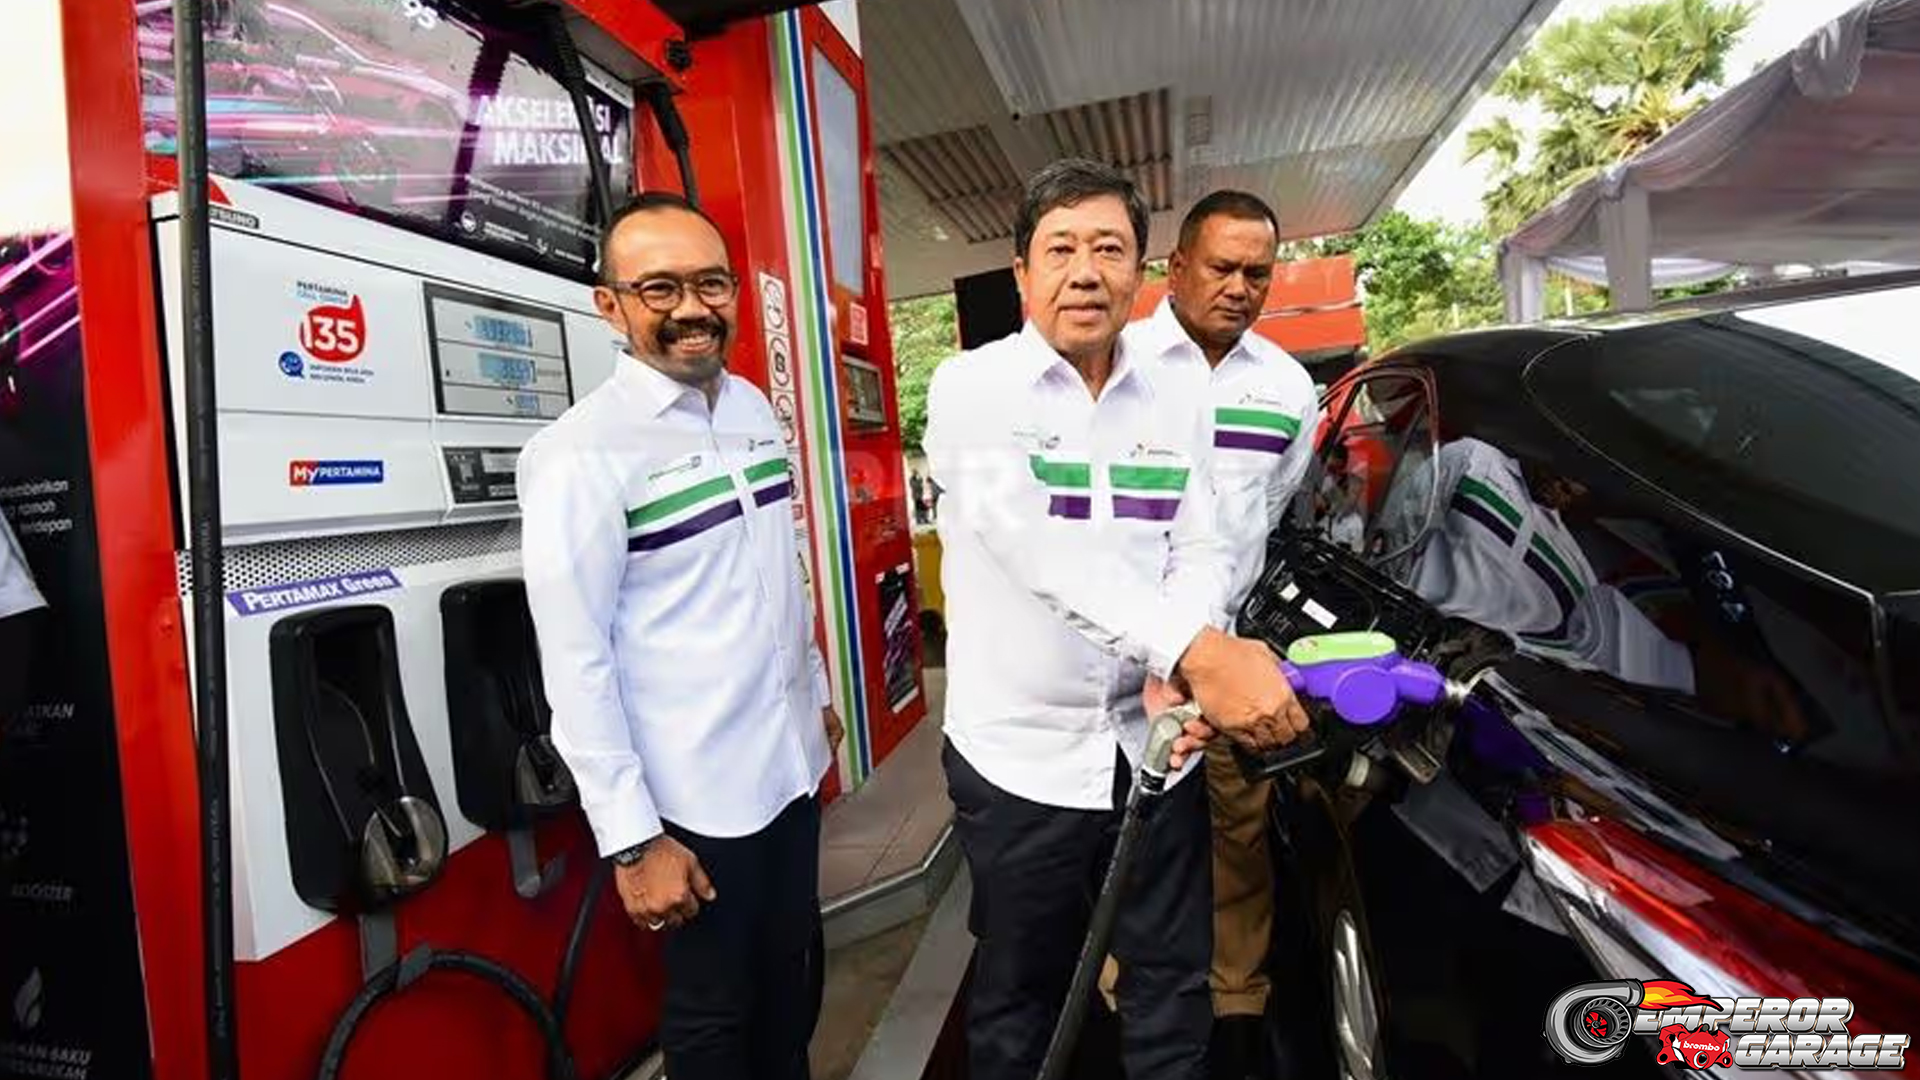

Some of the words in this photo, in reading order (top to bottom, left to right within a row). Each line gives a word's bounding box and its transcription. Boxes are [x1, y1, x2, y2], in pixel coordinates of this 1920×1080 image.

[475, 94, 611, 133] AKSELESI
[493, 131, 624, 165] MAKSIAL
[20, 518, 73, 536] depan
[241, 582, 343, 611] PERTAMAX
[341, 575, 394, 593] Green
